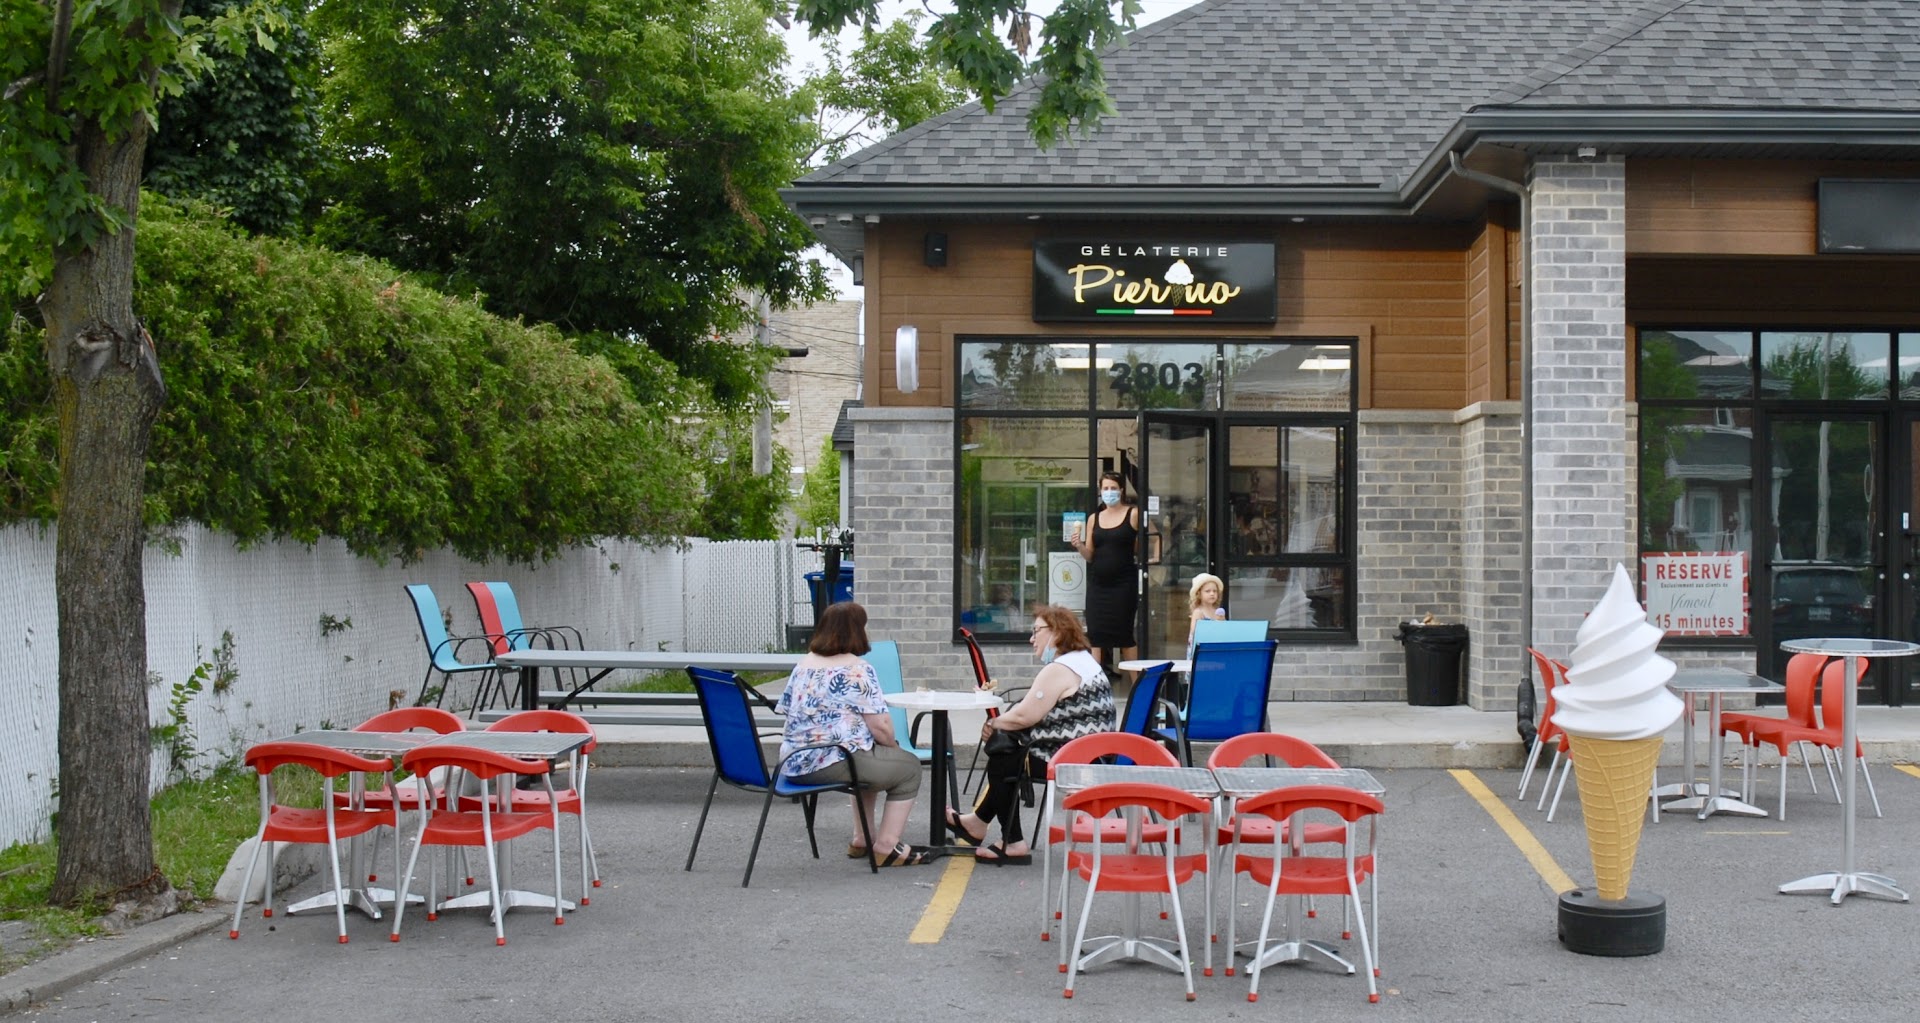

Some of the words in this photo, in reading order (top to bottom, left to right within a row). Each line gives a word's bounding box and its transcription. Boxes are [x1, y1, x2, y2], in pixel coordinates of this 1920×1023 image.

[1081, 244, 1228, 257] GÉLATERIE
[1109, 362, 1205, 390] 2803
[1656, 560, 1732, 580] RÉSERVÉ
[1656, 614, 1671, 629] 15
[1678, 614, 1734, 629] minutes
